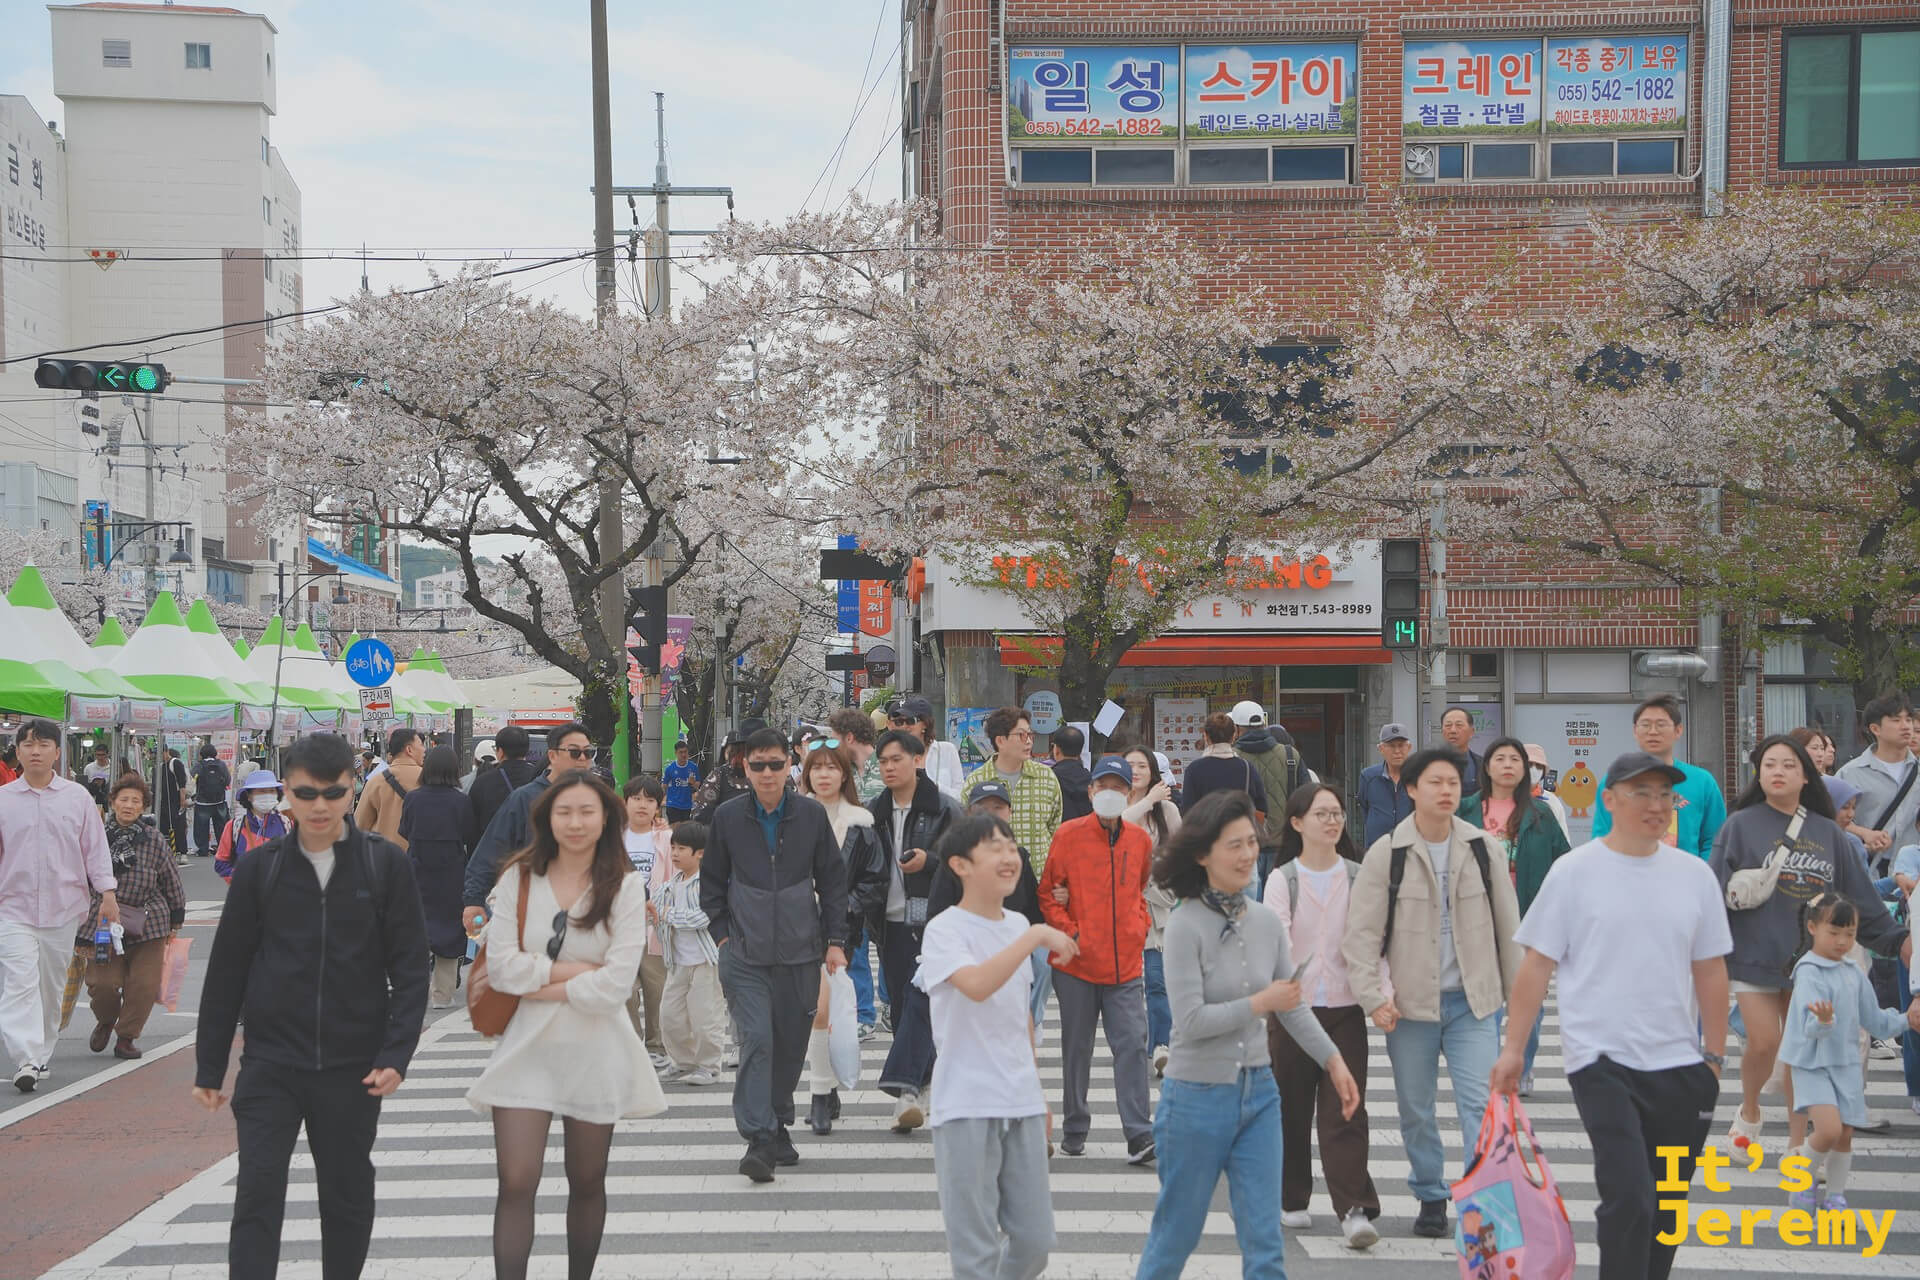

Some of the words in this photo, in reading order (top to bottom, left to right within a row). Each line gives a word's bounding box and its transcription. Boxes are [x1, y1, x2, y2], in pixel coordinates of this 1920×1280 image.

[1557, 47, 1591, 73] 각종
[1600, 46, 1634, 72] 중기
[1641, 45, 1678, 70] 보유
[1199, 57, 1344, 105] 스카이
[1412, 54, 1532, 97] 크레인
[1558, 83, 1587, 101] 055)
[1591, 77, 1675, 101] 542-1882
[1026, 121, 1061, 135] 055)
[1065, 118, 1162, 135] 542-1882
[866, 580, 884, 630] 대찌개
[1266, 604, 1299, 616] 화천점
[1394, 620, 1415, 643] 14
[362, 689, 390, 701] 구간시작
[367, 711, 390, 720] 300m
